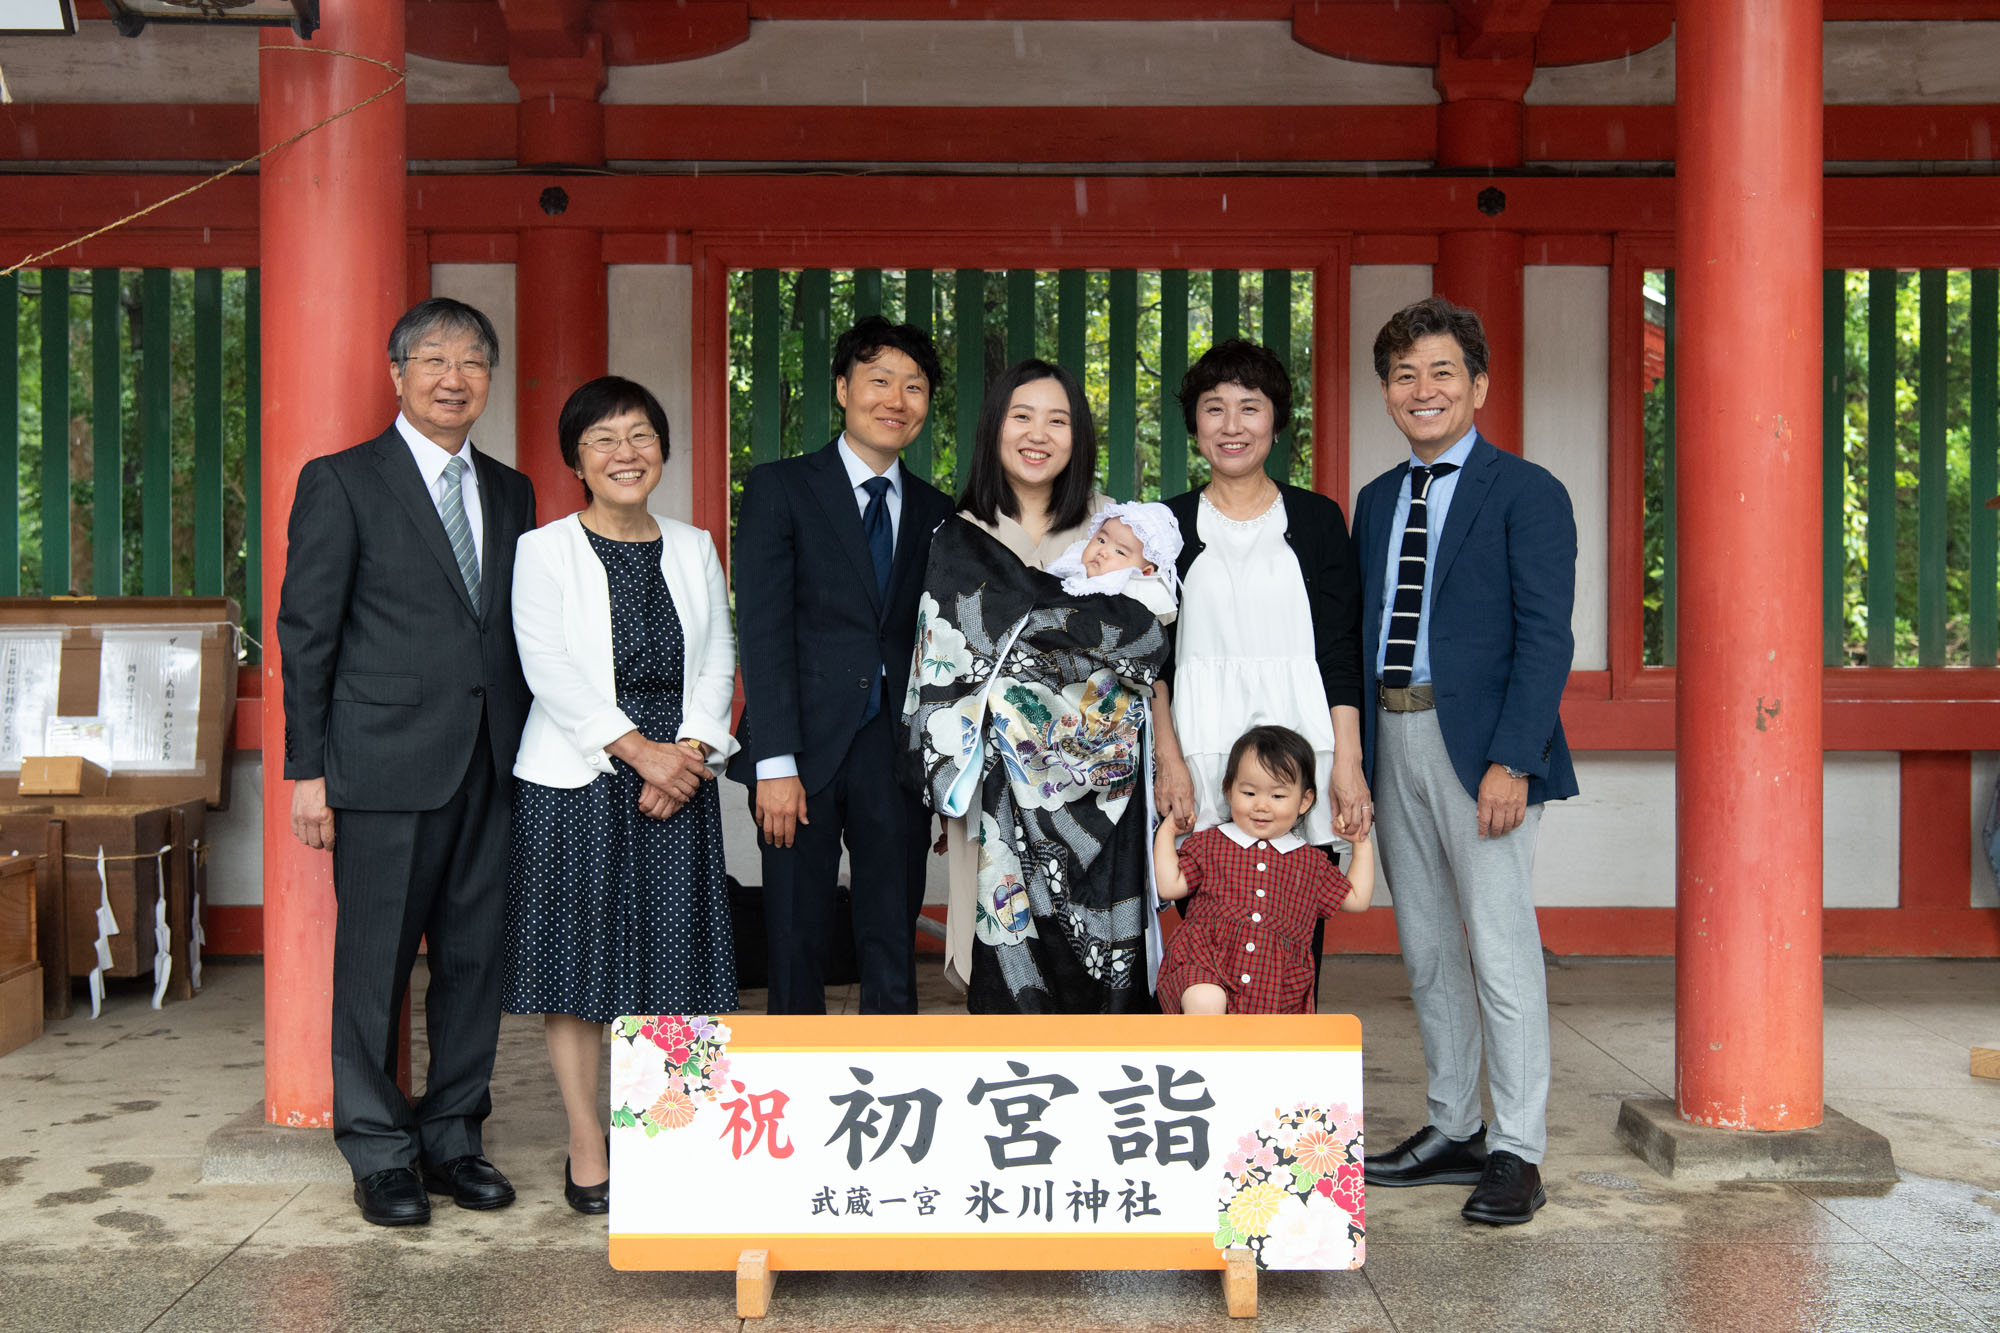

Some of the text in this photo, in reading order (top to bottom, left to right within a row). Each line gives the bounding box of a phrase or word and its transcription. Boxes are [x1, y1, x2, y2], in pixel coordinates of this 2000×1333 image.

[719, 1061, 1216, 1171] 祝 初宮詣
[812, 1178, 1162, 1224] 武蔵一宮 氷川神社
